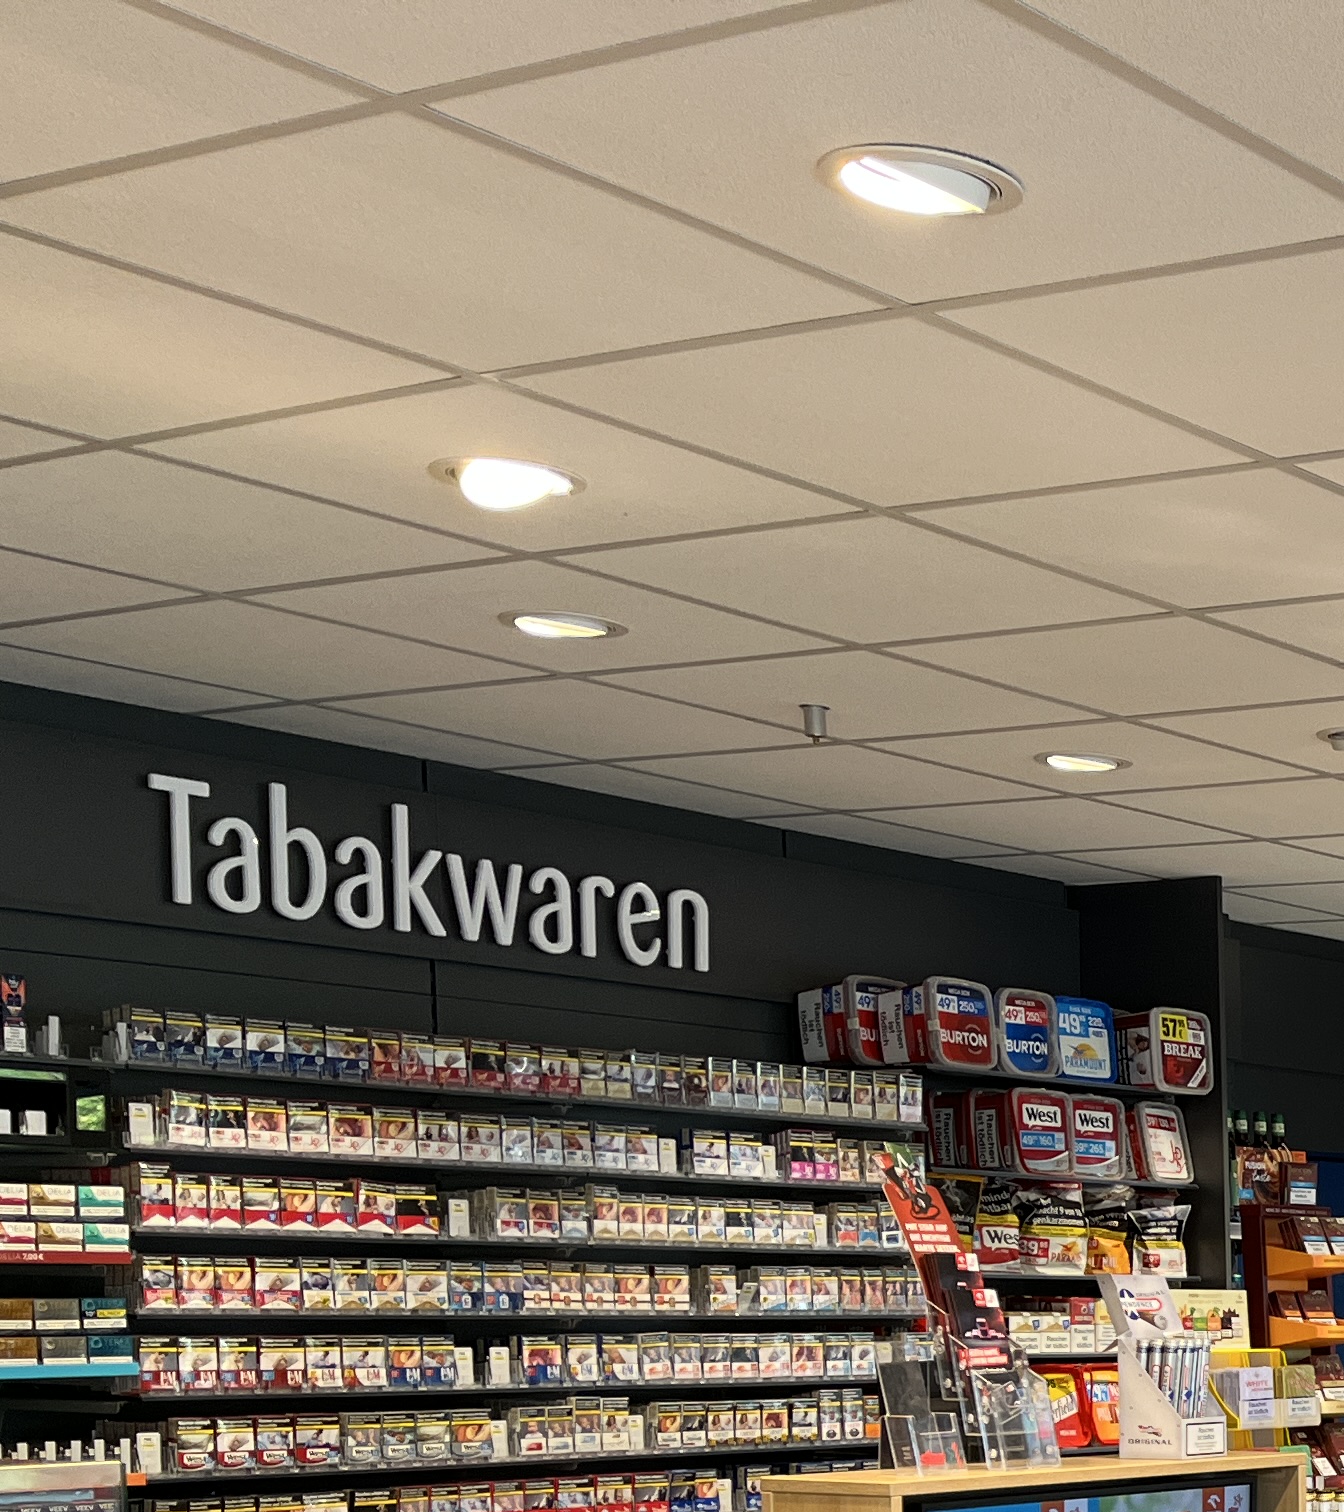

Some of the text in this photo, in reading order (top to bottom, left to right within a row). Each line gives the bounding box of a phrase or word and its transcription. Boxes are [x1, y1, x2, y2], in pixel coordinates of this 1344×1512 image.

[147, 773, 710, 973] Tabakwaren
[939, 1028, 988, 1048] BURTON
[1006, 1038, 1048, 1056] BURTON
[1163, 1043, 1203, 1059] BREAK
[1064, 1055, 1107, 1072] PARAMOUNT
[1025, 1108, 1059, 1124] West
[1078, 1112, 1111, 1130] West
[986, 1228, 1020, 1246] Wes
[1127, 1438, 1173, 1446] ORIGINAL
